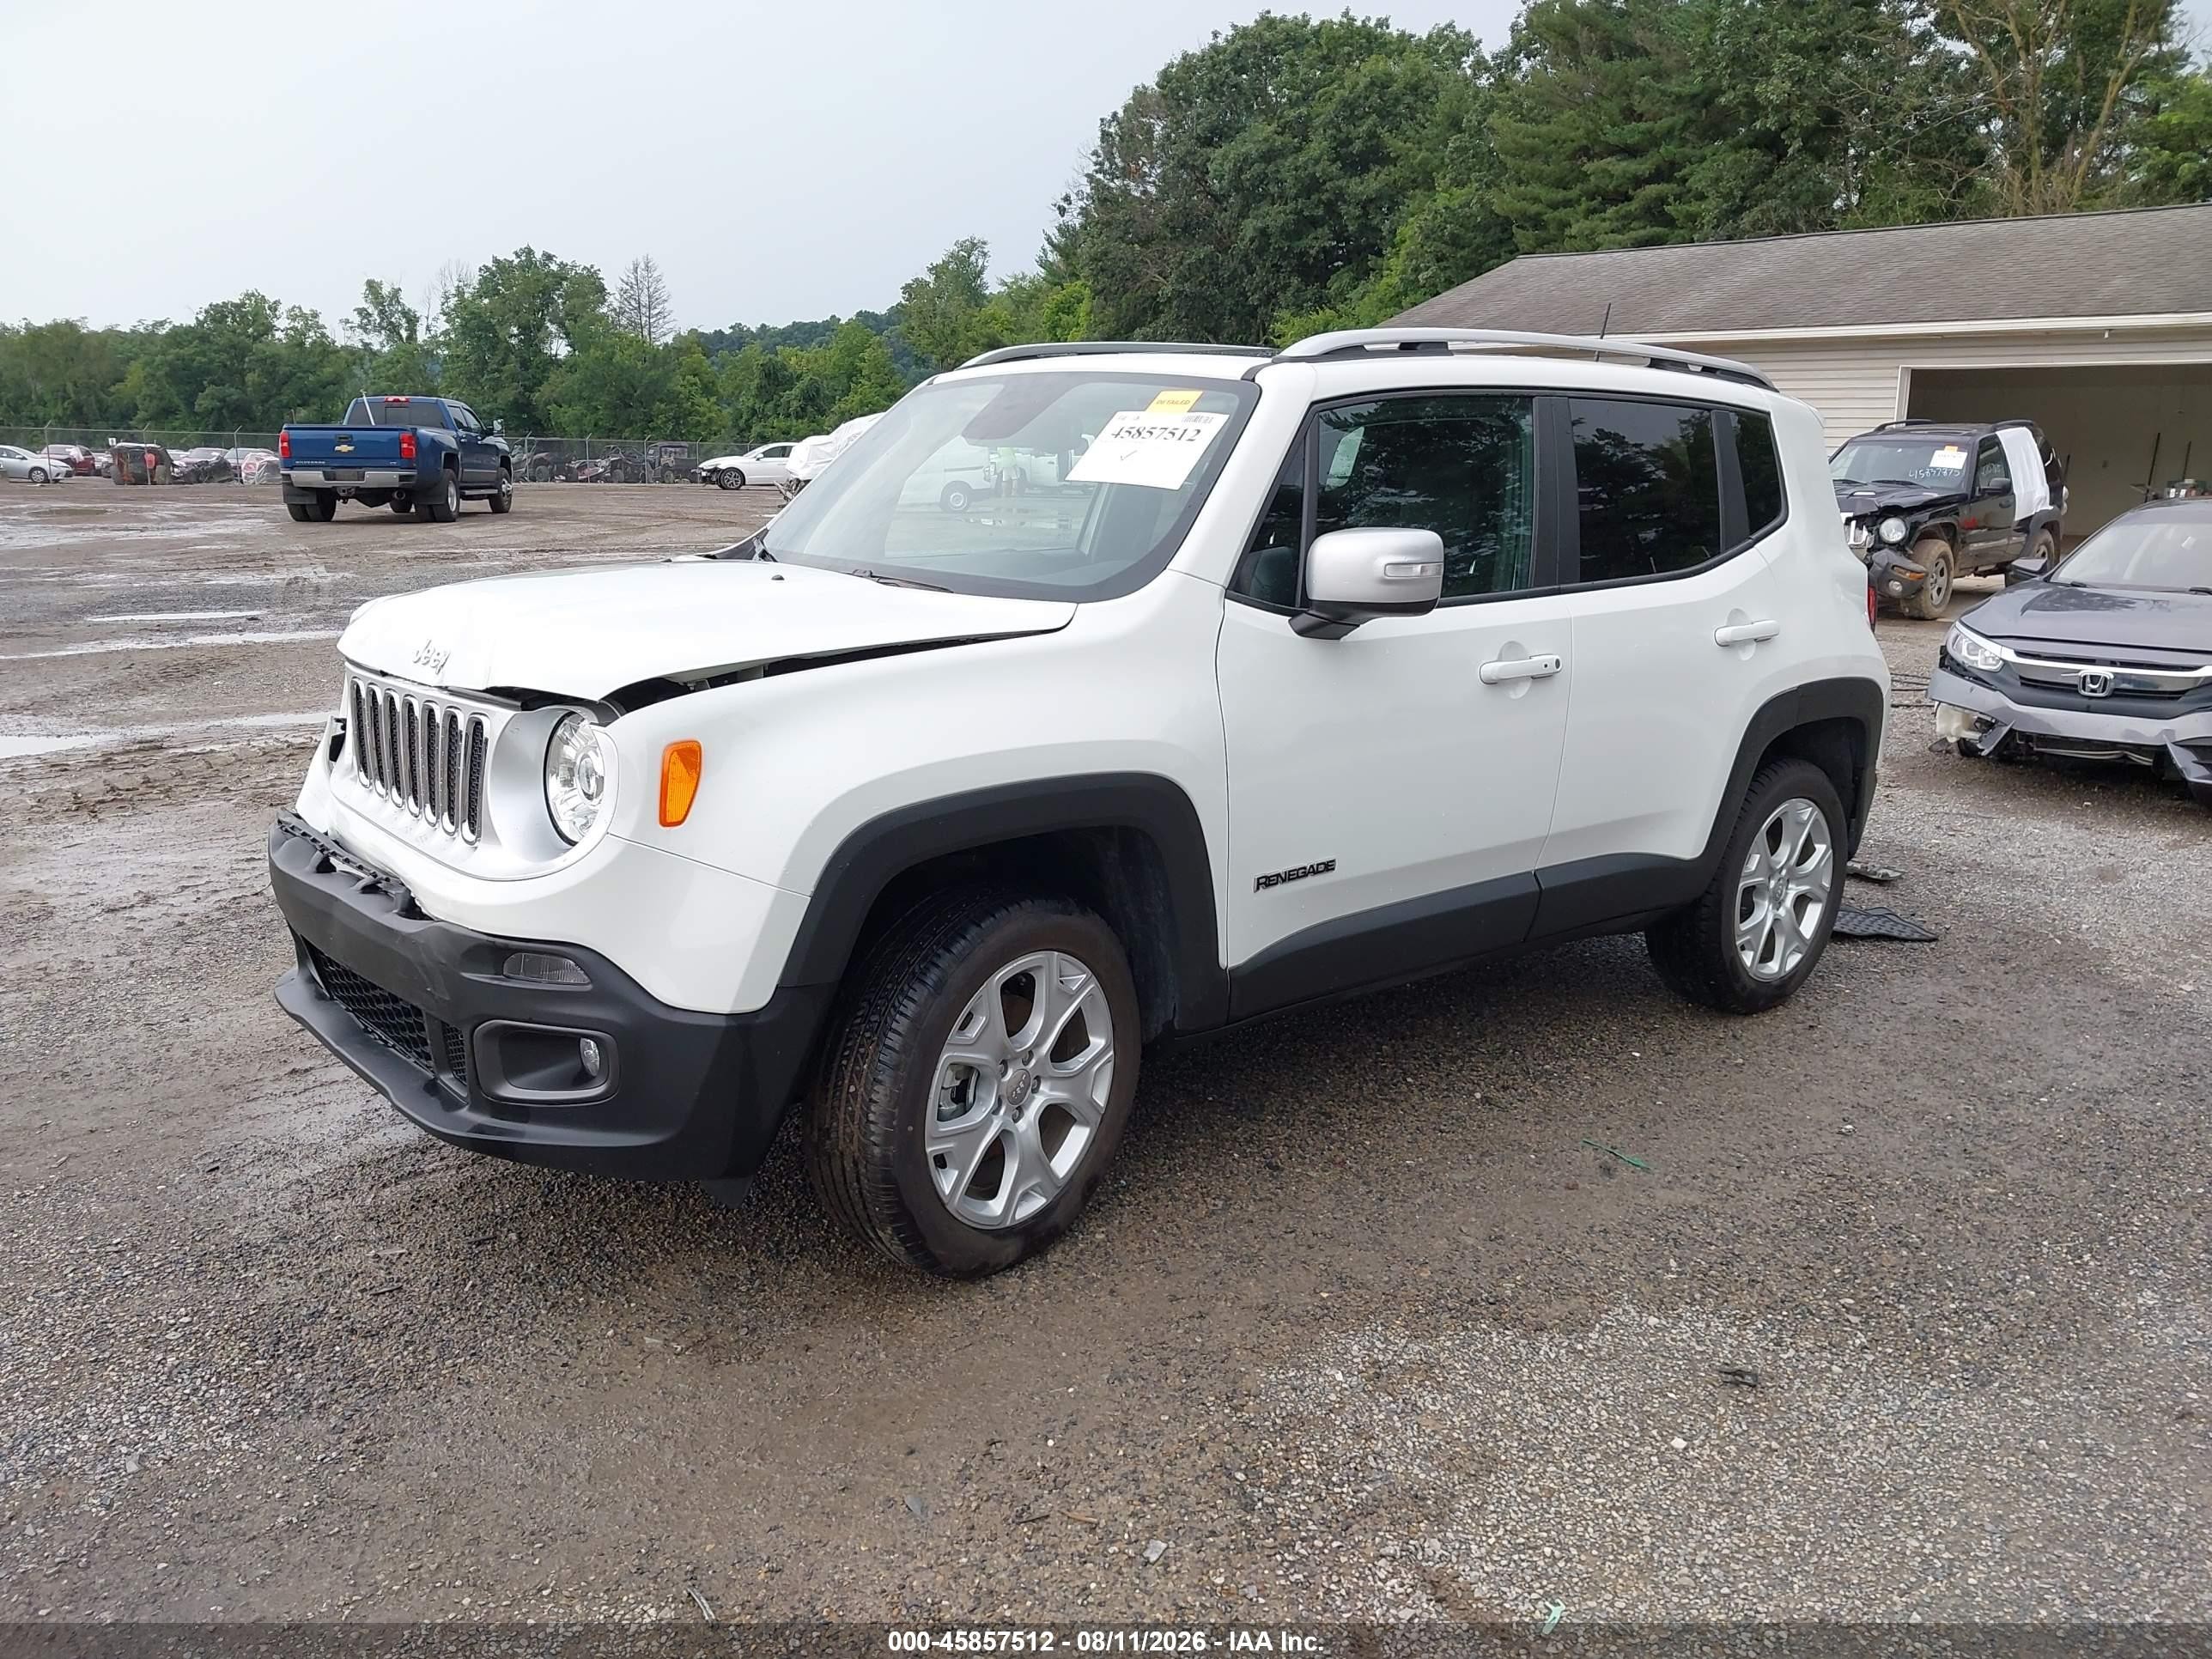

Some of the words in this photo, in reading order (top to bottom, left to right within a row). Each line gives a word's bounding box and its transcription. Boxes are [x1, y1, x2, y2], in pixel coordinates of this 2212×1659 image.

[1111, 426, 1201, 441] 45857512
[412, 639, 451, 675] Jeep
[1254, 858, 1337, 893] RENEGADE
